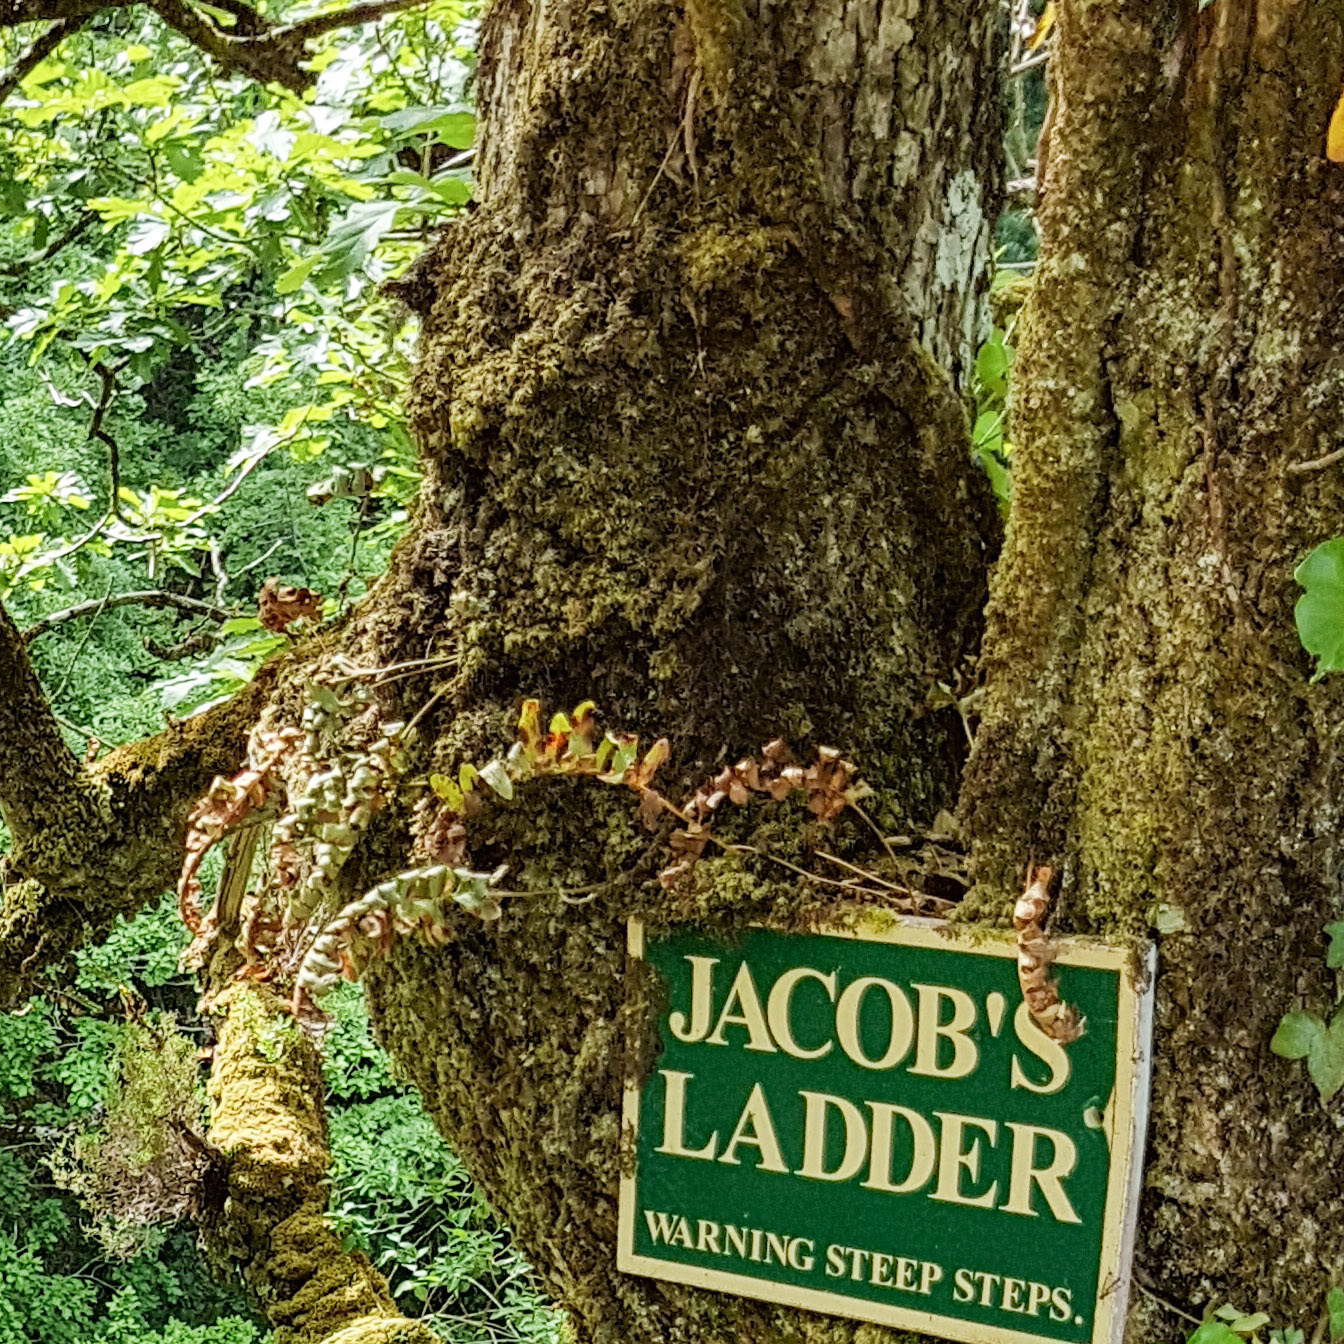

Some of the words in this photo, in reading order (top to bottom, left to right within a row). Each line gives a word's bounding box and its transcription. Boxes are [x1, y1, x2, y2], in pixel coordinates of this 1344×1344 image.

[668, 954, 1072, 1094] JACOB'S
[654, 1069, 1082, 1225] LADDER
[644, 1210, 815, 1272] WARNING
[825, 1244, 943, 1295] STEEP
[953, 1268, 1084, 1325] STEPS.
